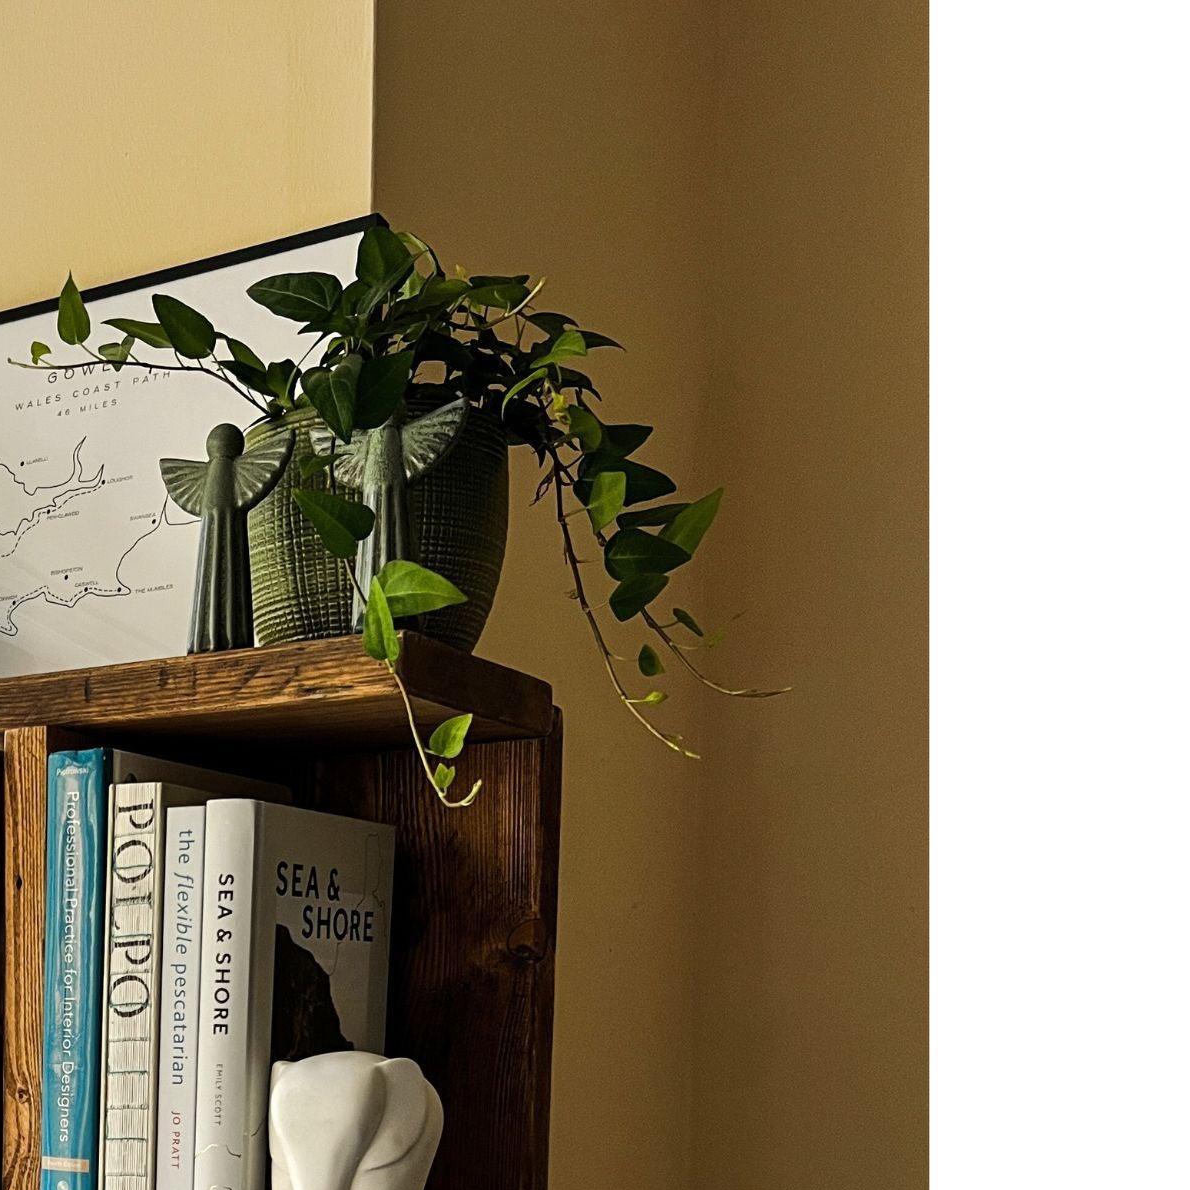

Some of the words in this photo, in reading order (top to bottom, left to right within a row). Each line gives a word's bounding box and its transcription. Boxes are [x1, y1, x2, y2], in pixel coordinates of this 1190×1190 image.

[15, 394, 61, 411] WALES
[72, 381, 121, 398] COAST
[132, 371, 171, 385] PATH
[80, 399, 118, 413] MILES
[62, 791, 80, 894] Professional
[178, 829, 195, 864] the
[217, 874, 234, 920] SEA
[276, 861, 320, 899] SEA
[327, 868, 340, 901] &
[62, 898, 78, 964] Practice
[173, 871, 194, 955] flexible
[302, 905, 374, 942] SHORE
[216, 929, 232, 942] &
[62, 969, 76, 990] for
[213, 952, 231, 1035] SHORE
[60, 994, 74, 1060] Interior
[171, 963, 187, 1085] pescatarian
[215, 1063, 223, 1091] EMILY
[57, 1062, 75, 1143] Designers
[171, 1111, 180, 1125] JO
[214, 1094, 222, 1126] SCOTT
[171, 1131, 180, 1170] PRATT
